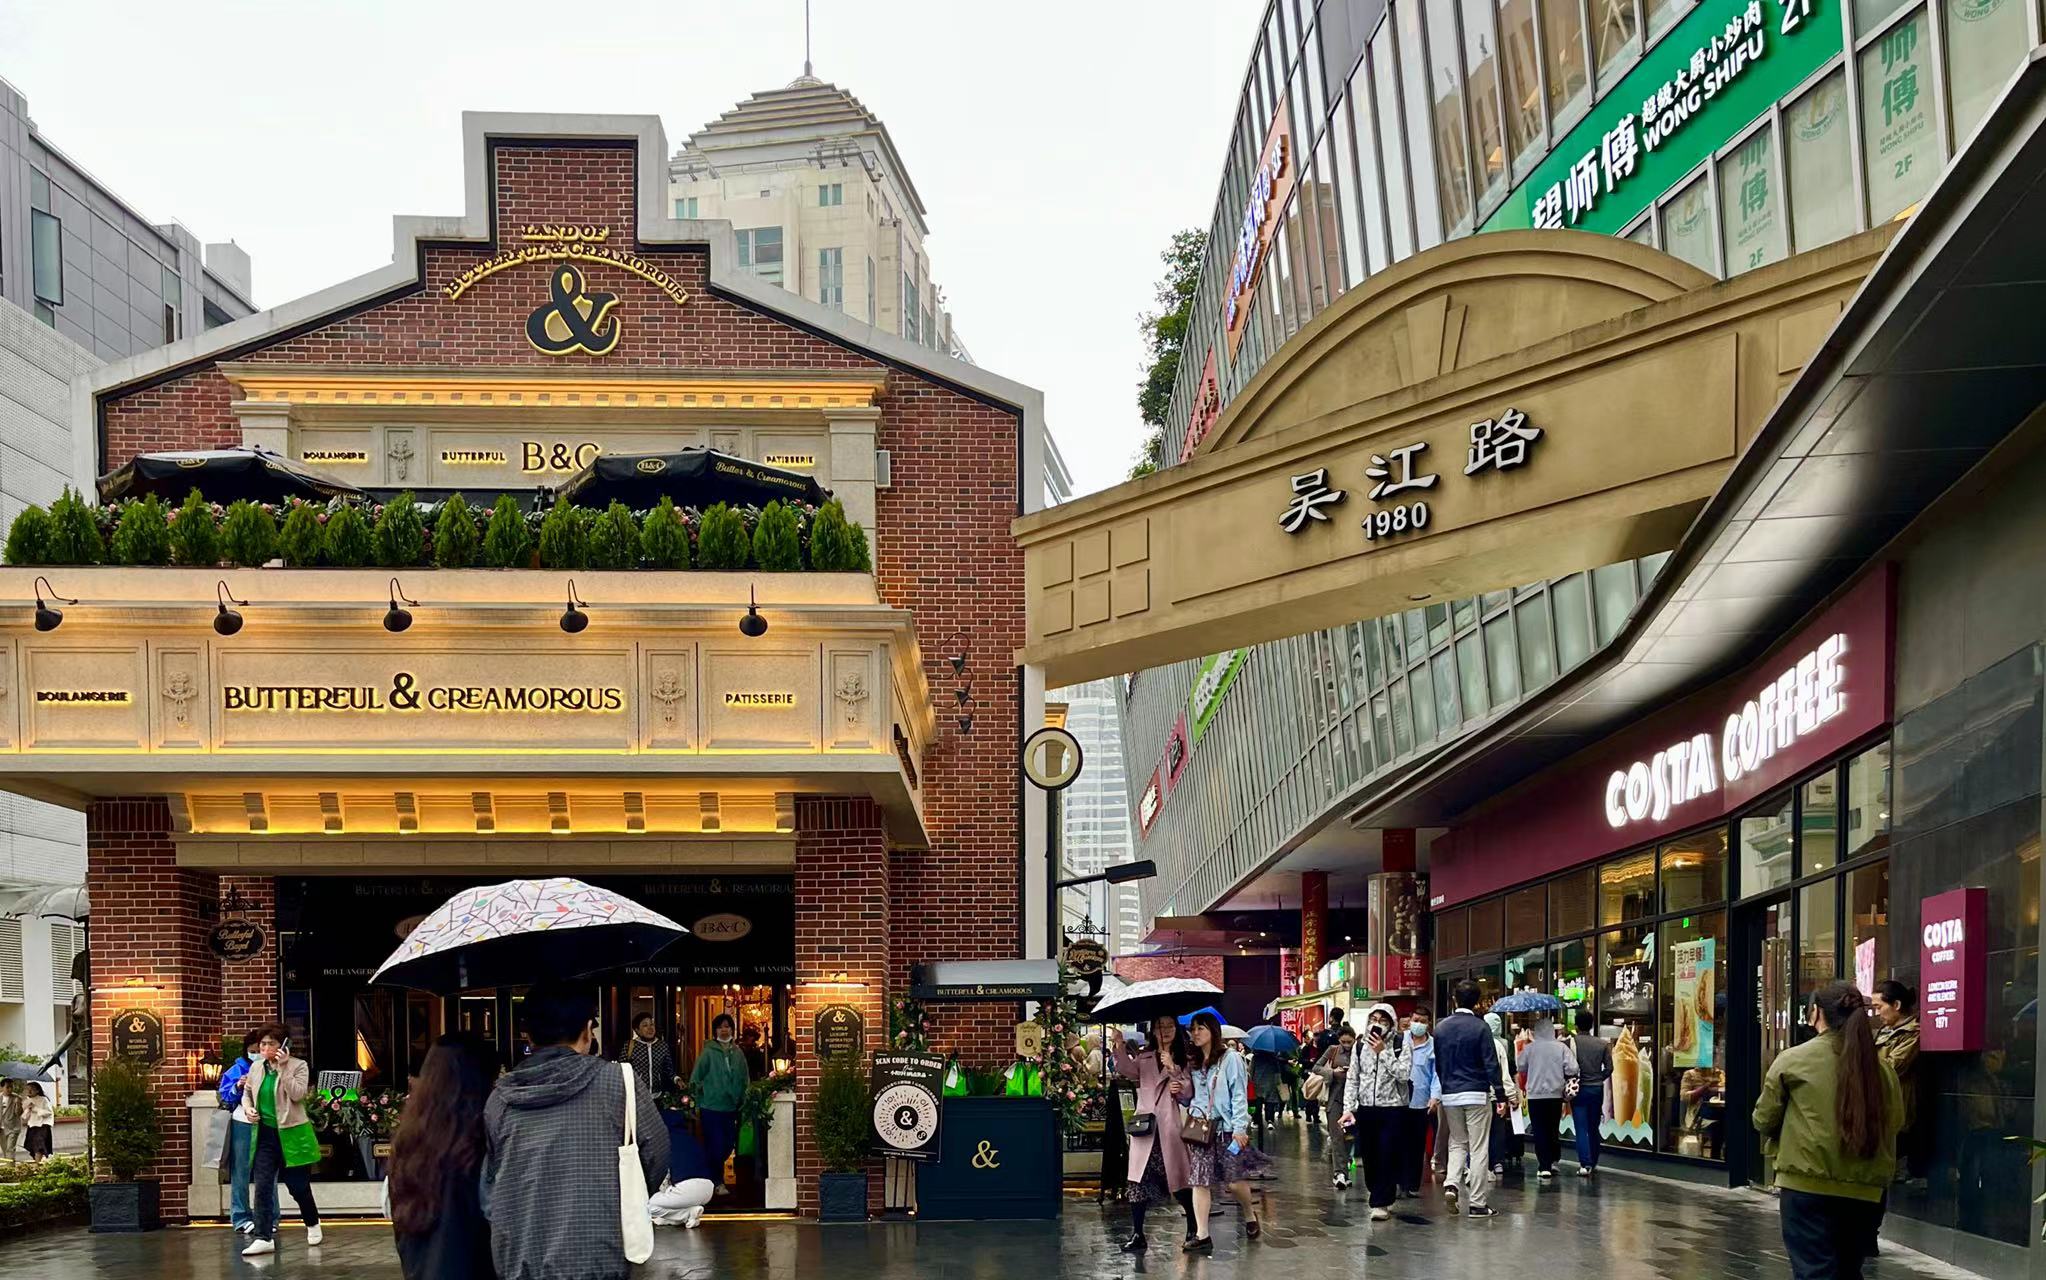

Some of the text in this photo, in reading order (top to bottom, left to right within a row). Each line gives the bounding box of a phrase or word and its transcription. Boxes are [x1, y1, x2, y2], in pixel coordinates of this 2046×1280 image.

[1964, 8, 1990, 18] WONG
[1642, 1, 1762, 128] 超级大厨小炒肉
[1643, 29, 1764, 152] WONG SHIFU
[1880, 136, 1902, 155] WONG
[1532, 113, 1638, 229] 望师傅
[1894, 153, 1912, 178] 2F
[522, 223, 609, 241] LAND OF
[1749, 247, 1763, 268] 2F
[569, 240, 689, 304] CREAMOROUS
[525, 264, 621, 355] &
[303, 451, 367, 462] BOULANGERIE
[441, 450, 507, 462] BUTTERFUL
[640, 461, 664, 470] B&C
[765, 455, 815, 465] PATISSERIE
[1278, 407, 1544, 535] 吴江路
[1362, 501, 1429, 540] 1980
[36, 691, 129, 702] BOULANGERIE
[224, 672, 623, 710] BUTTERFUL & CREAMOROUS
[725, 693, 794, 704] PATISSERIE
[1722, 633, 1848, 781] COFFEE
[1605, 733, 1718, 828] COSTA
[702, 921, 747, 934] B&C
[1923, 918, 1964, 949] COSTA
[1931, 949, 1956, 964] COFFEE
[694, 966, 741, 975] PATISSERIE
[975, 984, 985, 995] &
[875, 1057, 891, 1066] SCAN
[892, 1057, 909, 1065] CODE
[910, 1057, 919, 1066] TO
[920, 1059, 943, 1070] ORDER
[899, 1110, 913, 1126] &
[972, 1140, 1000, 1169] &
